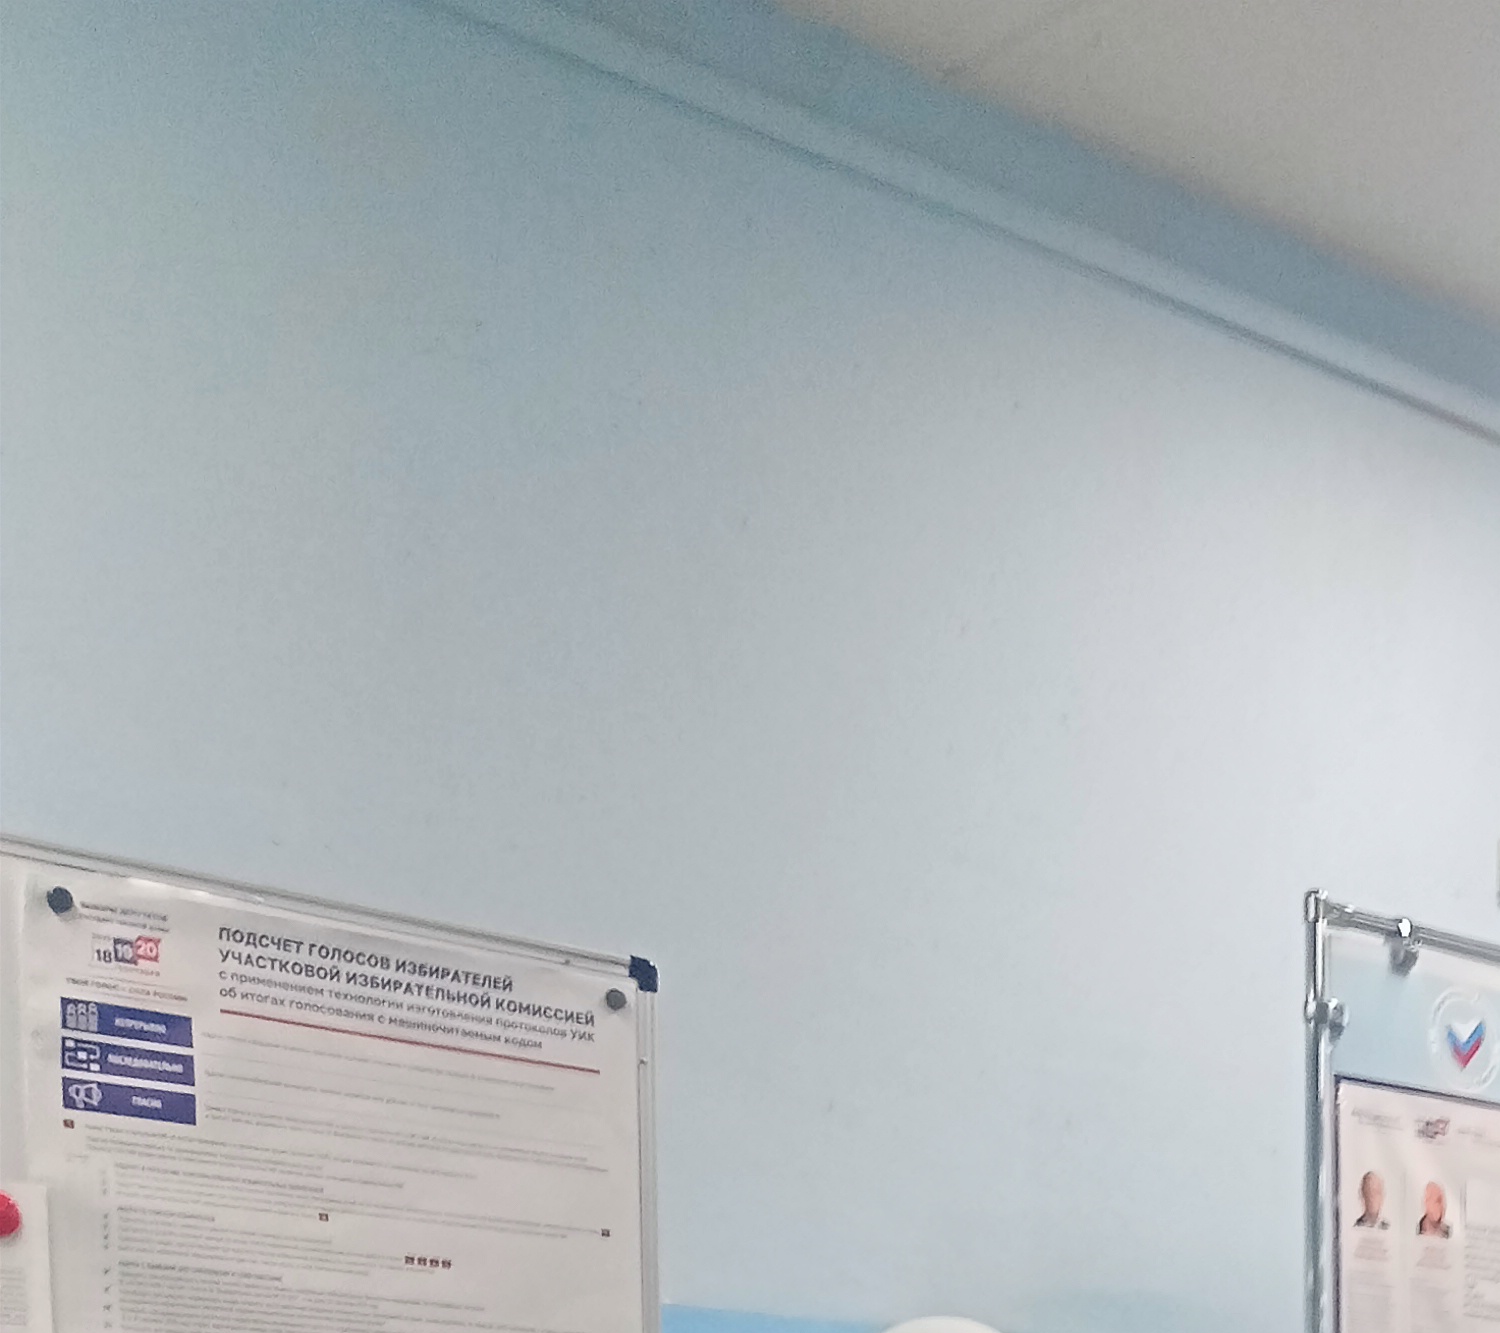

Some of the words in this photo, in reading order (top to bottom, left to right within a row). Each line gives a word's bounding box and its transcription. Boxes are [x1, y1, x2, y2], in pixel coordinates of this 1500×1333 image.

[135, 939, 158, 961] 20
[218, 926, 303, 954] ПОДСЧЕТ
[308, 942, 391, 970] ГОЛОСОВ
[395, 958, 513, 992] ИЗБИРАТЕЛЕЙ
[219, 948, 341, 983] УЧАСТКОВОЙ
[346, 972, 491, 1009] ИЗБИРАТЕЛЬНОЙ
[495, 997, 595, 1027] КОМИССИЕЙ
[219, 970, 228, 980] с
[231, 972, 324, 997] применением
[329, 989, 403, 1010] технологии
[570, 1029, 595, 1043] УИК
[219, 987, 237, 999] об
[241, 992, 285, 1007] итогах
[289, 1001, 374, 1022] голосования
[377, 1014, 386, 1024] с
[504, 1035, 543, 1049] кодом
